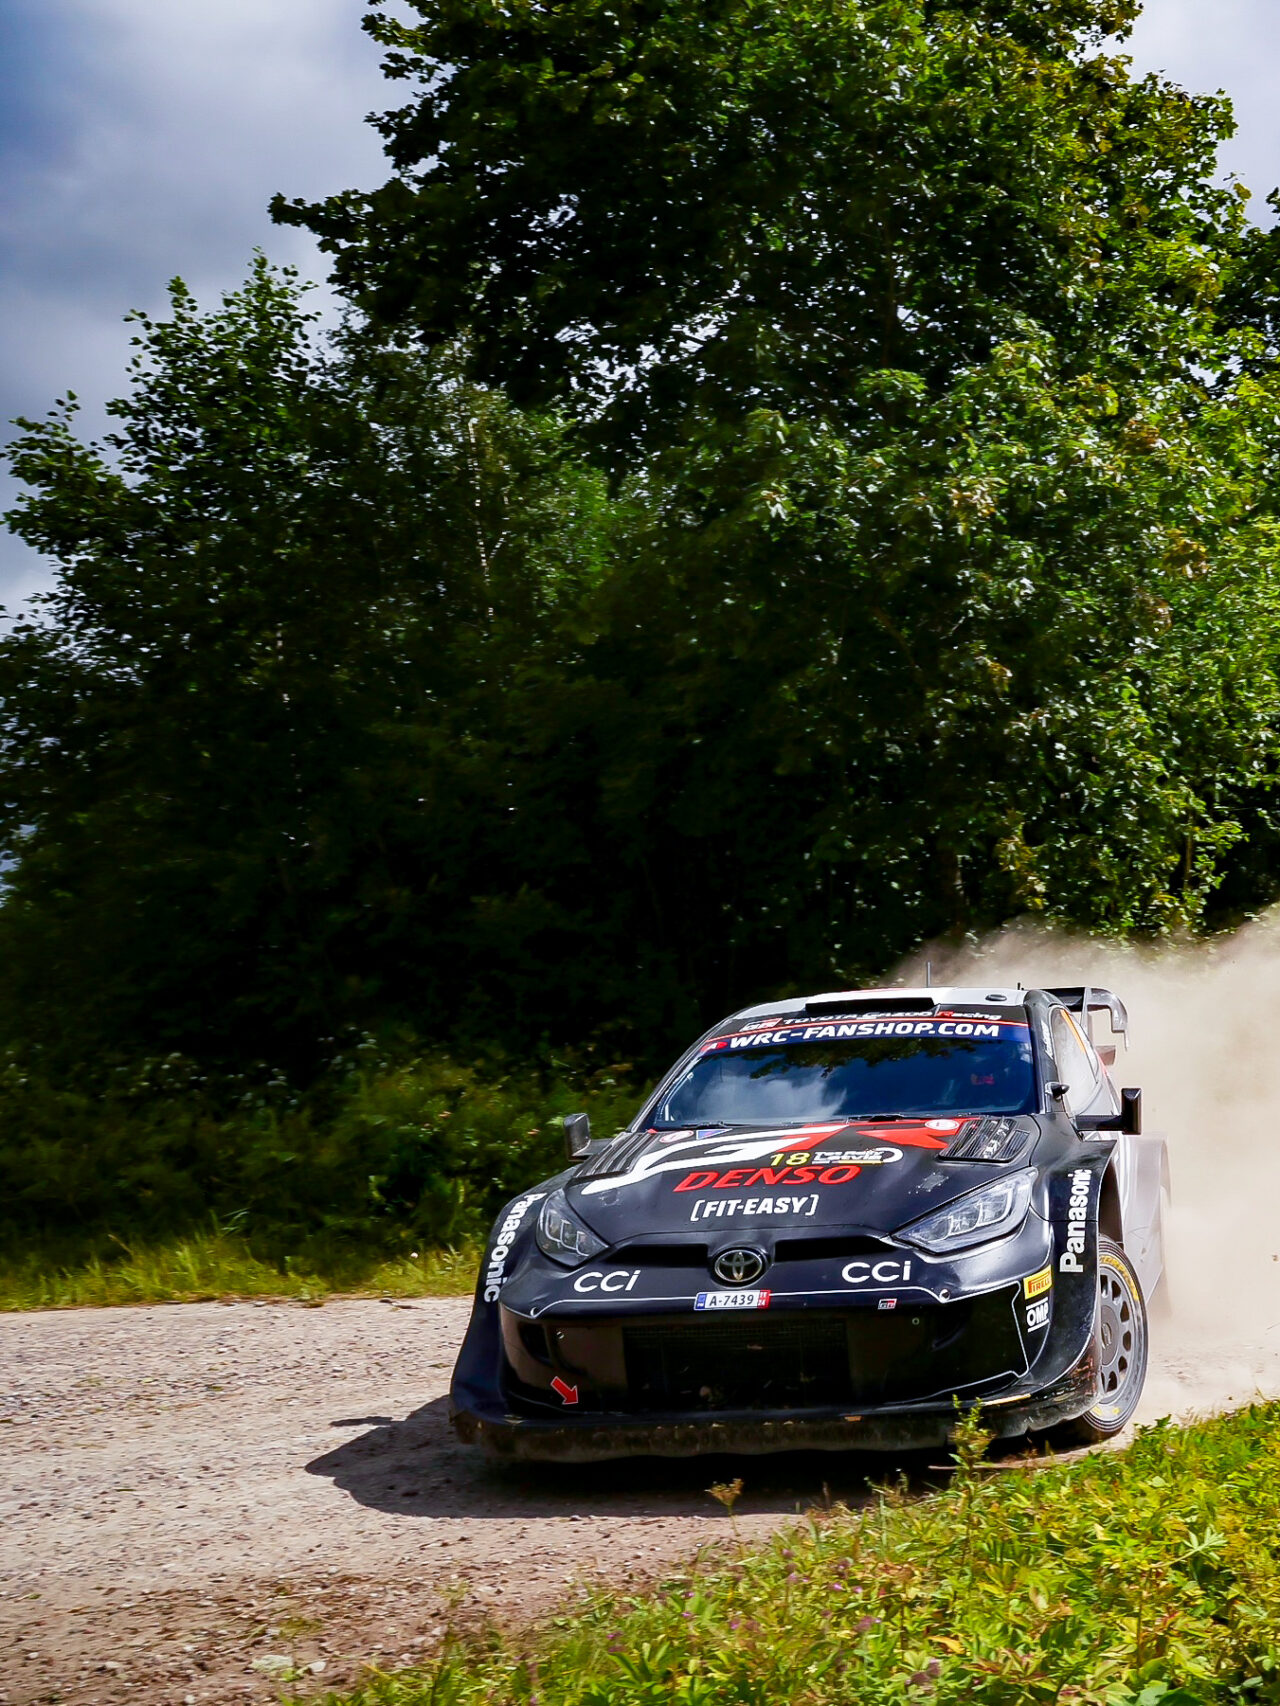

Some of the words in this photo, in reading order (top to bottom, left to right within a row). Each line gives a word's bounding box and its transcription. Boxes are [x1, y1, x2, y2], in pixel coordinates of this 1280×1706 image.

[730, 1022, 999, 1049] WRC-FANSHOP.COM
[770, 1153, 811, 1167] 18
[673, 1165, 861, 1192] DENSO
[1059, 1168, 1093, 1273] Panasonic
[484, 1193, 548, 1302] Panasonic
[709, 1294, 754, 1306] A-7439
[1026, 1302, 1049, 1327] OMP
